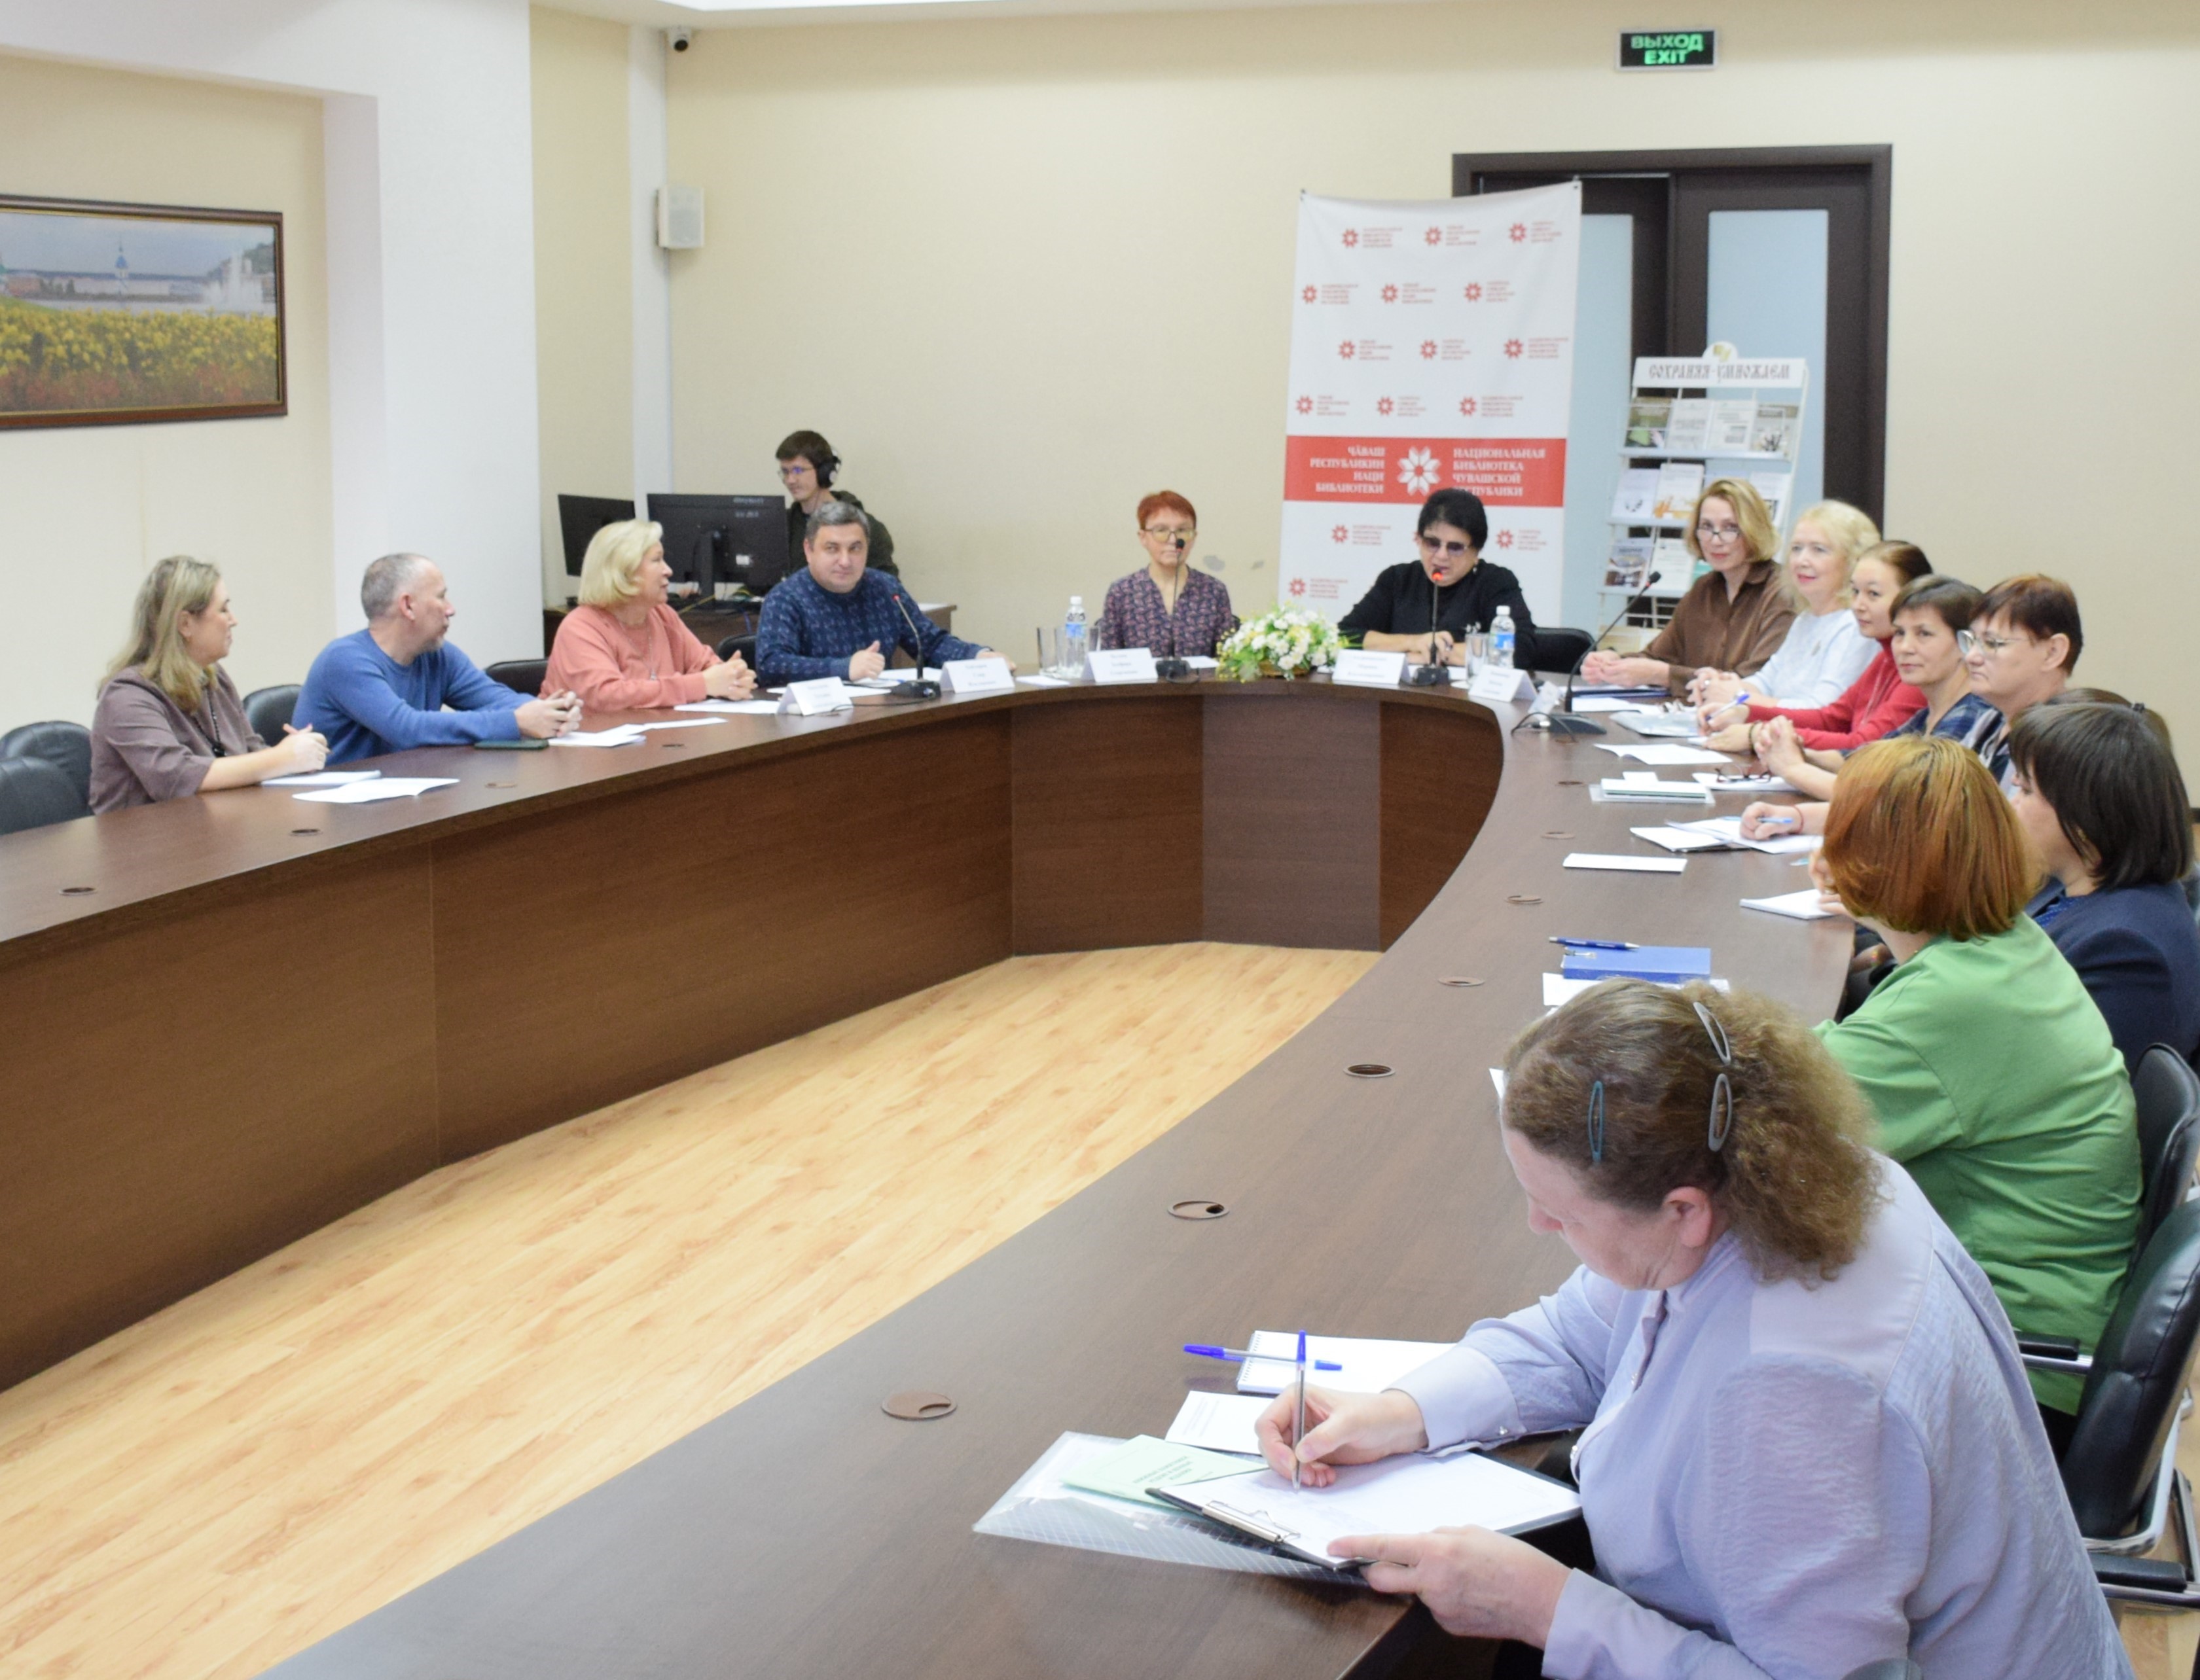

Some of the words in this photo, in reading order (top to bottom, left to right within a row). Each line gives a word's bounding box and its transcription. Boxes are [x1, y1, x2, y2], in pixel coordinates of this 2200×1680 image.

[1631, 34, 1704, 52] ВЫХОД
[1644, 49, 1689, 65] EXIT
[1452, 448, 1545, 460] НАЦИОНАЛЬНАЯ
[1452, 460, 1524, 471] БИБЛИОТЕКА
[1452, 473, 1521, 484] ЧУВАШСКОЙ
[1315, 482, 1384, 495] БИБЛИОТЕКИ
